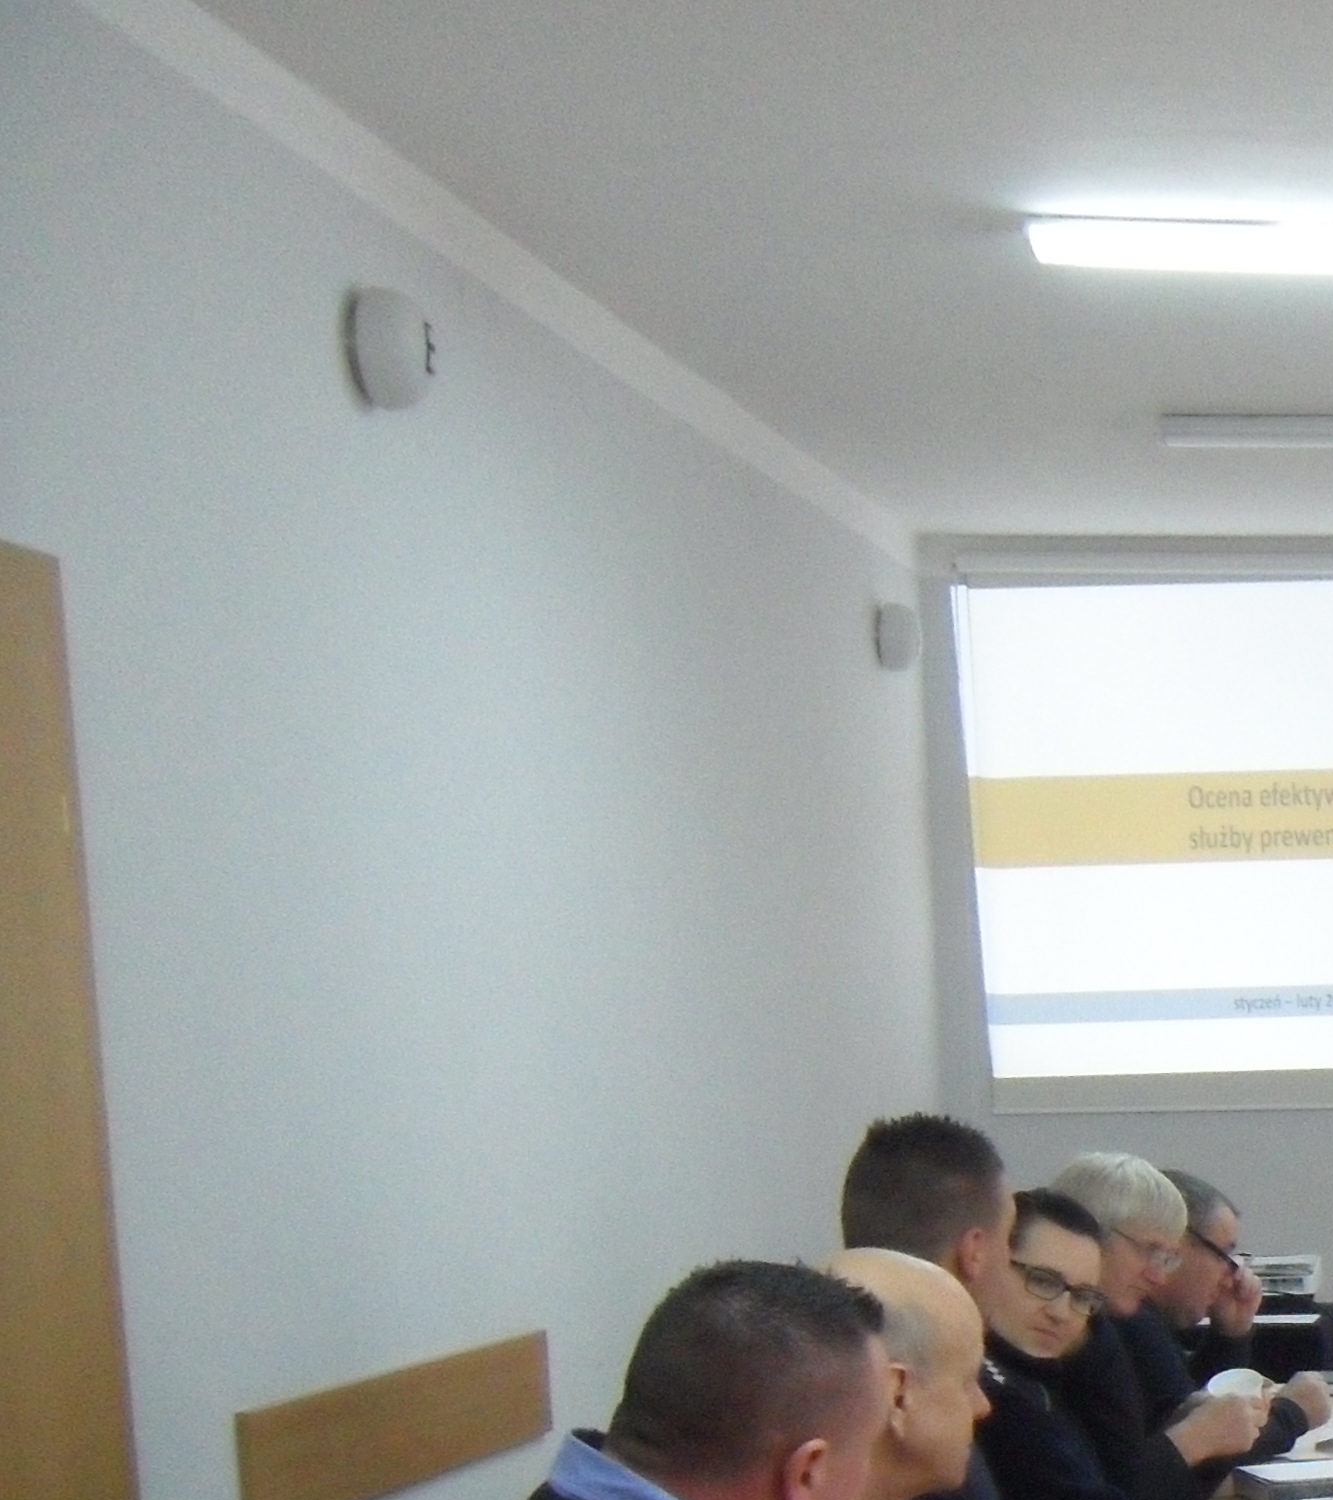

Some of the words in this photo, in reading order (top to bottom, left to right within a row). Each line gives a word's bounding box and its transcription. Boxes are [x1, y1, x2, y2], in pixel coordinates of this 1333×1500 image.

[1188, 785, 1251, 809] Ocena
[1189, 824, 1253, 853] służby
[1234, 995, 1282, 1013] styczeń
[1296, 994, 1322, 1011] luty
